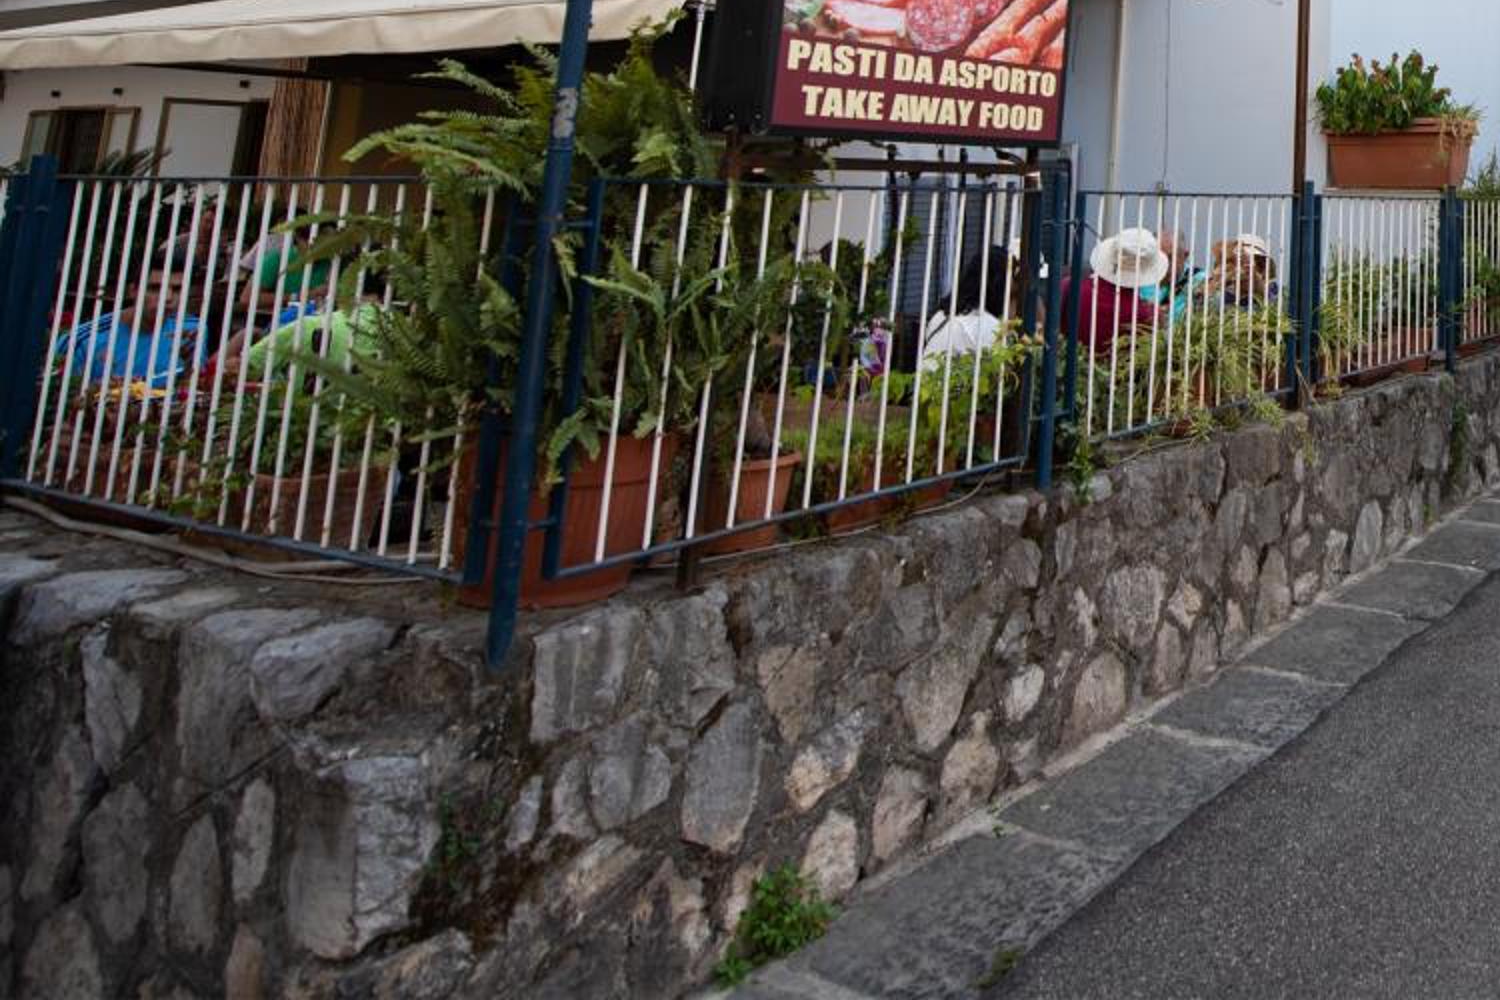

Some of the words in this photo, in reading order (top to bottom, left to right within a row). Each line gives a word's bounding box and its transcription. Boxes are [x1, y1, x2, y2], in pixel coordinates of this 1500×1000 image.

[787, 39, 887, 80] PASTI
[894, 52, 934, 84] DA
[939, 58, 1057, 98] ASPORTO
[801, 85, 885, 121] TAKE
[889, 94, 976, 128] AWAY
[979, 101, 1044, 132] FOOD
